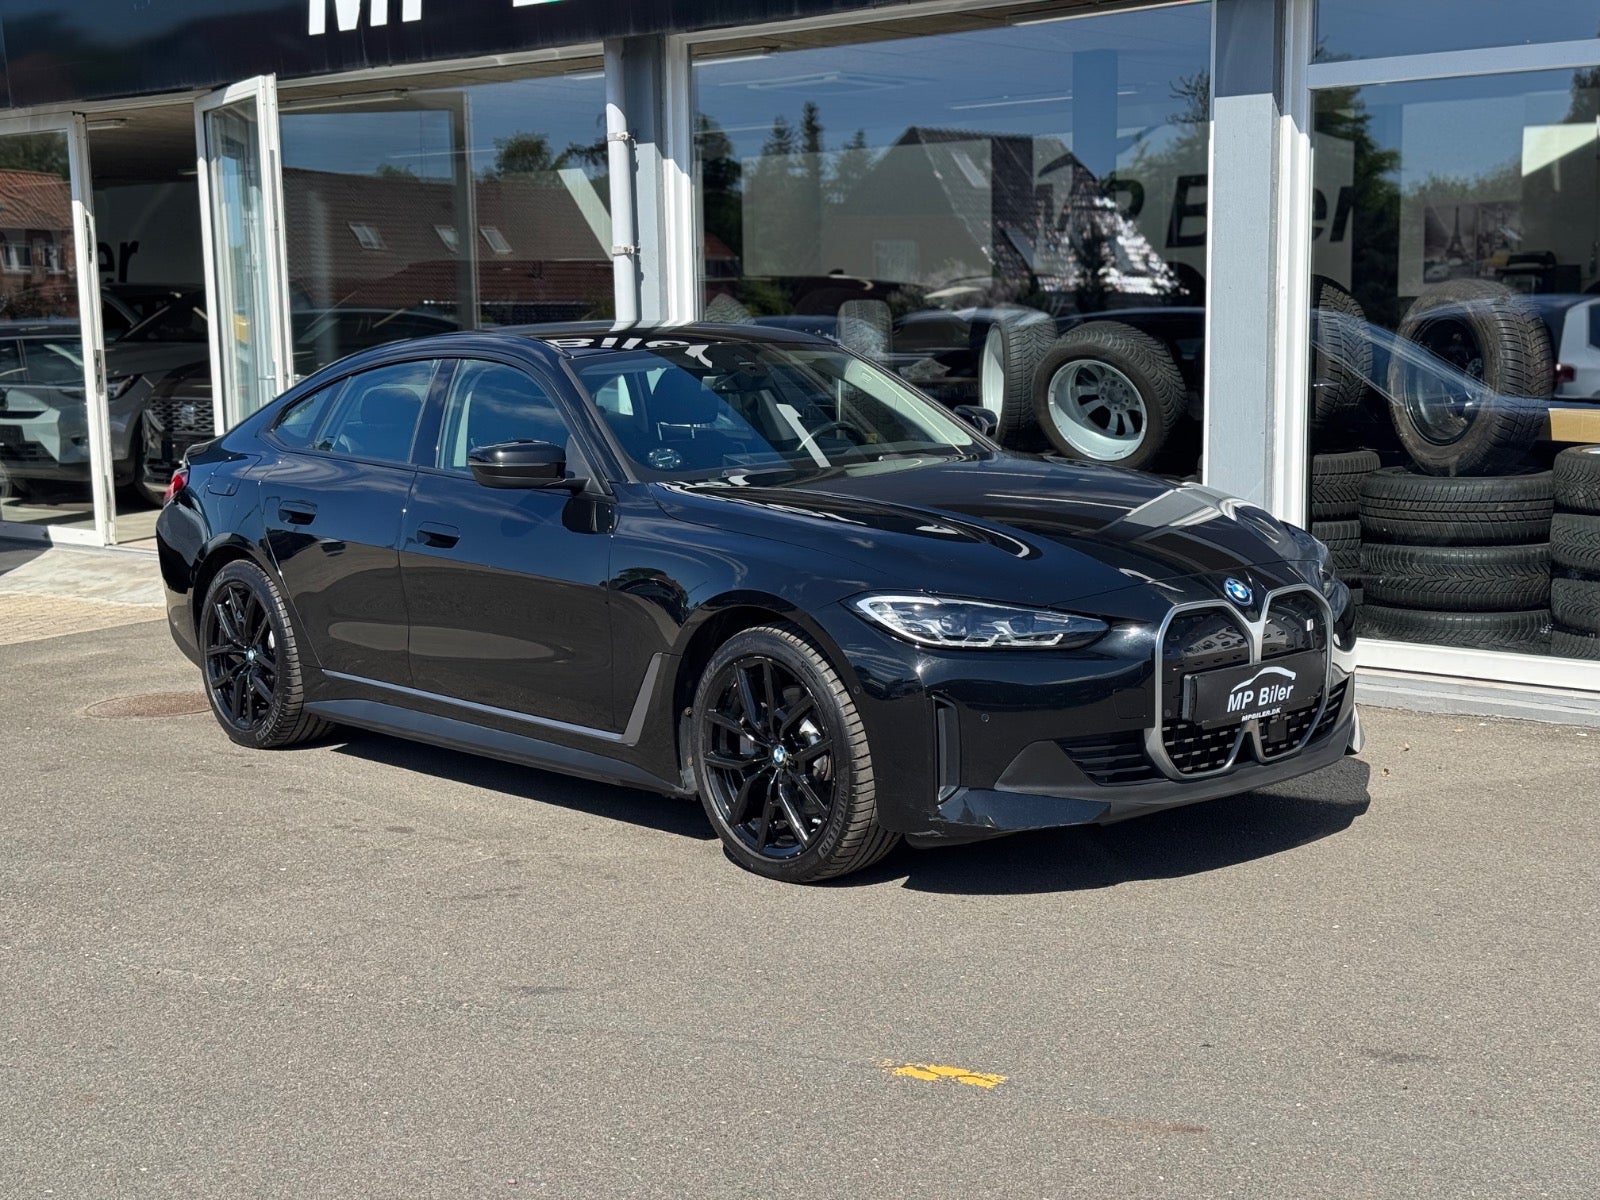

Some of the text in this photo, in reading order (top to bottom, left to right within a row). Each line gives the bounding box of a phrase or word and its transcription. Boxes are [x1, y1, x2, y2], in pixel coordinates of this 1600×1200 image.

[1226, 685, 1294, 713] MP Biler
[820, 789, 849, 856] MICHELIN
